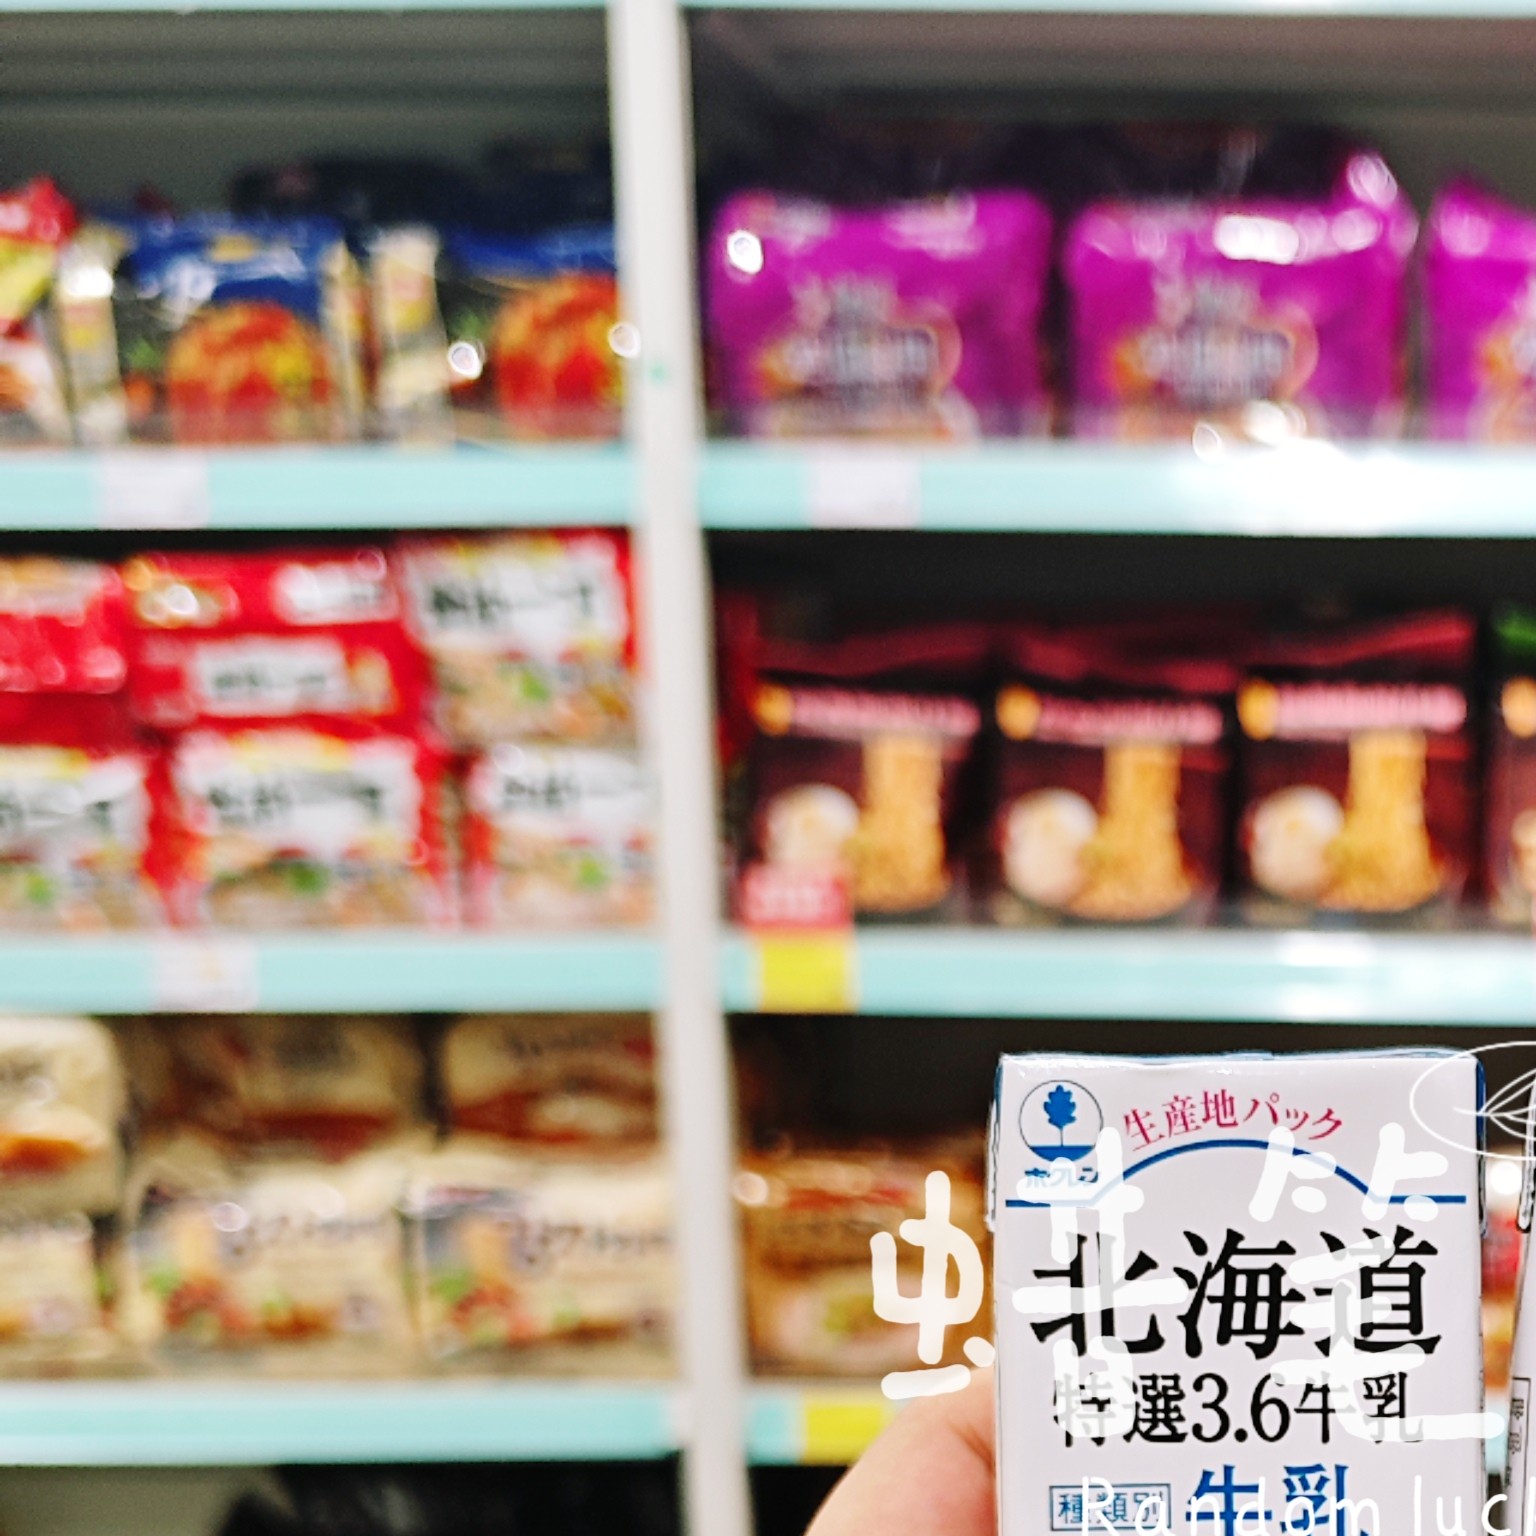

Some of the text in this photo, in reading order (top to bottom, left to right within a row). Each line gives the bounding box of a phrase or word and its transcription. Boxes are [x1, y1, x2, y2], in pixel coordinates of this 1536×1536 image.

[1123, 1089, 1343, 1152] 生産地パック
[1029, 1225, 1443, 1360] 北海道
[1056, 1489, 1166, 1526] 種類別
